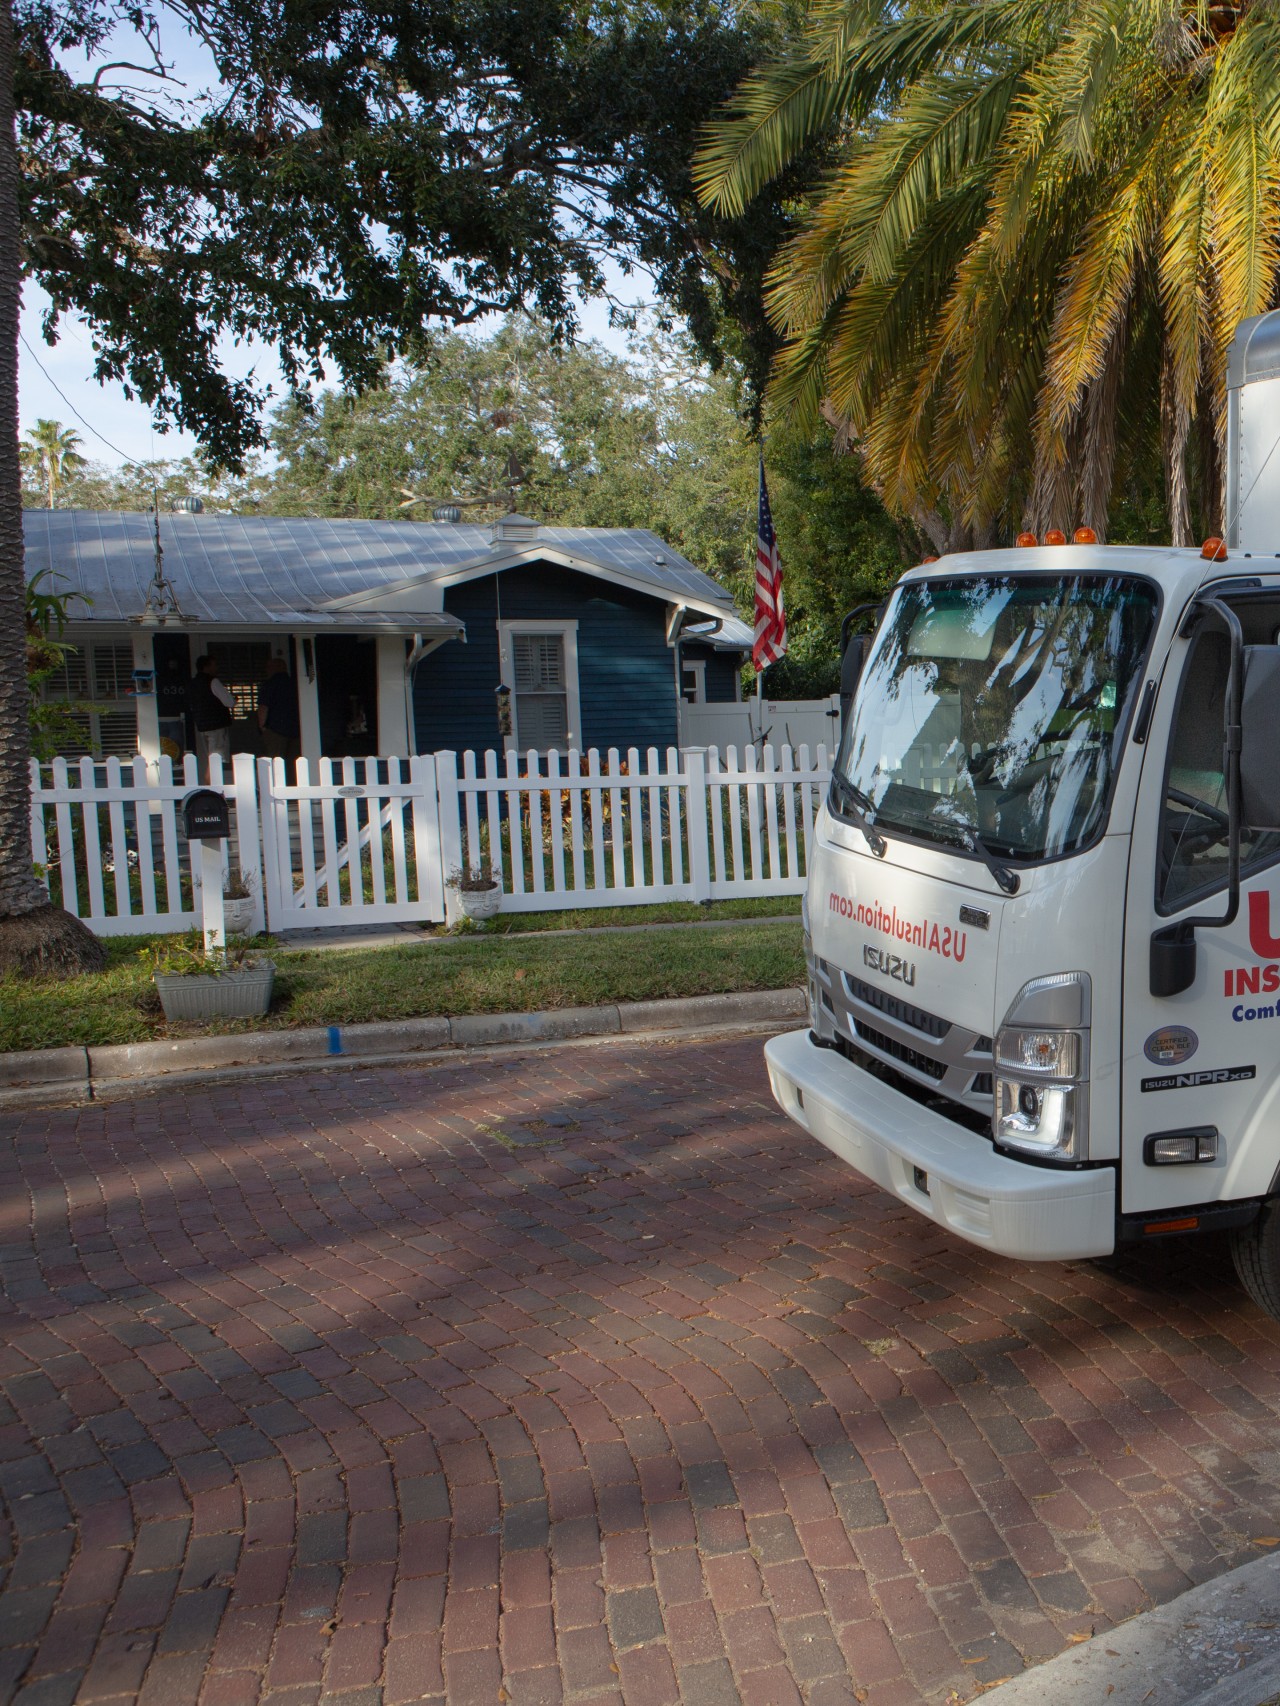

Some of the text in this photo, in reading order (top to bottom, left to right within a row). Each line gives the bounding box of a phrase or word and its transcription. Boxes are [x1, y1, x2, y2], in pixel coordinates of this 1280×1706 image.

[163, 685, 185, 695] 636
[863, 942, 916, 987] ISUZU
[1155, 1037, 1188, 1046] CERTIFIED
[1177, 1041, 1191, 1050] IDLE
[1145, 1079, 1175, 1089] ISUZU
